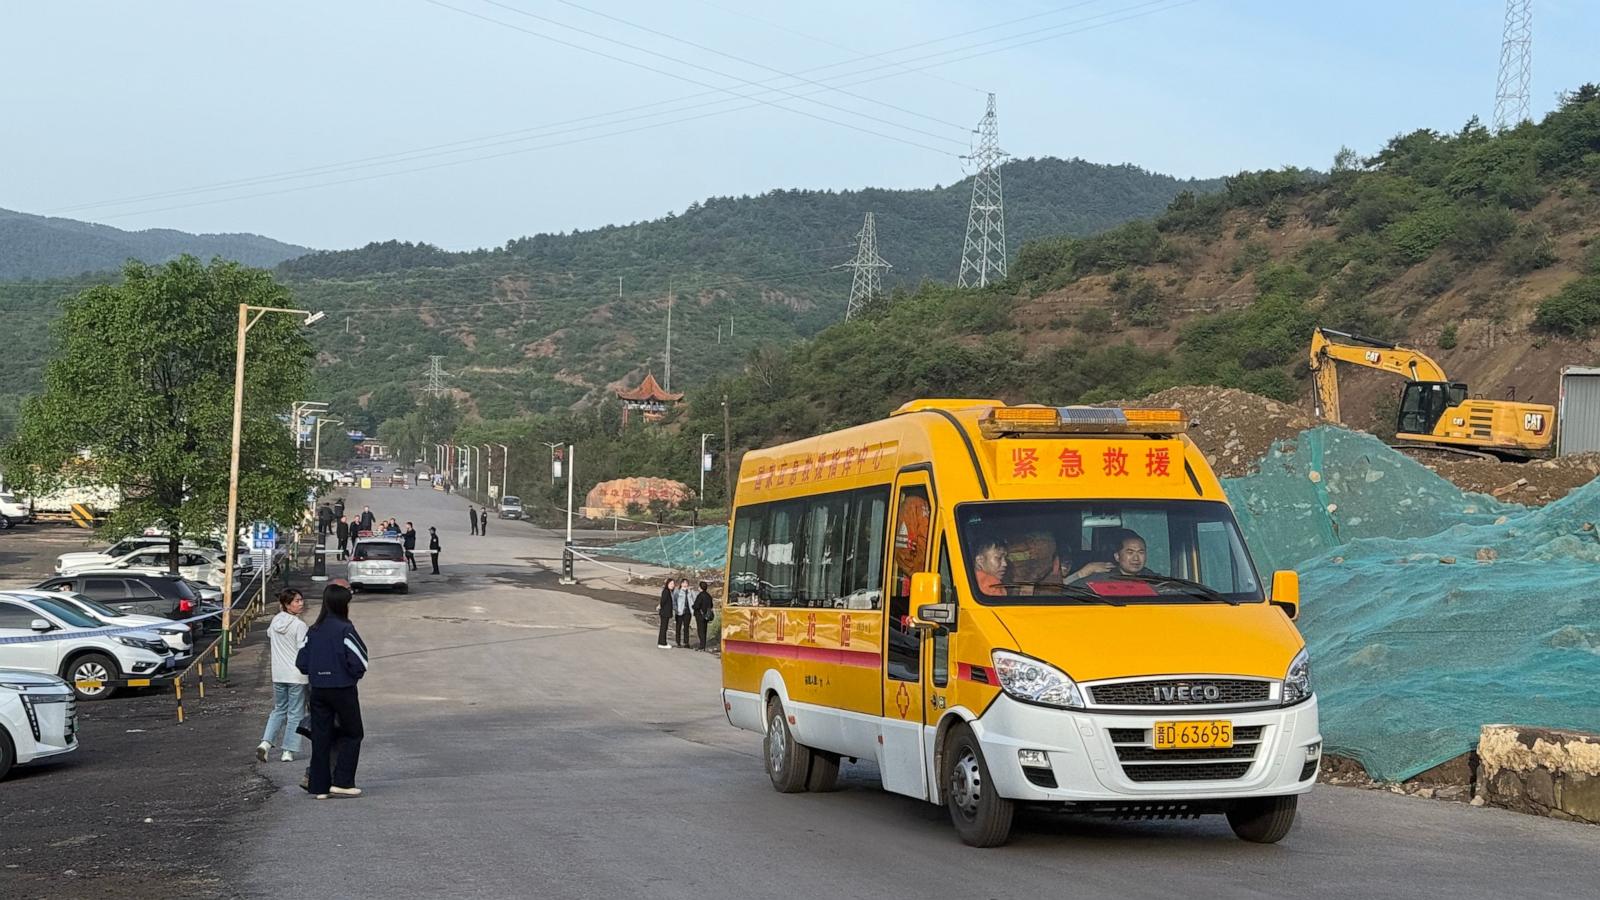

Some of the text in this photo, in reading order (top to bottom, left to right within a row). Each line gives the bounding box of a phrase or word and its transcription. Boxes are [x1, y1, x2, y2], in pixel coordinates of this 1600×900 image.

[1365, 351, 1380, 362] CAT
[1452, 418, 1464, 426] CAT
[1524, 413, 1543, 431] CAT
[1012, 446, 1170, 479] 紧急救援
[1153, 686, 1220, 700] IVECO
